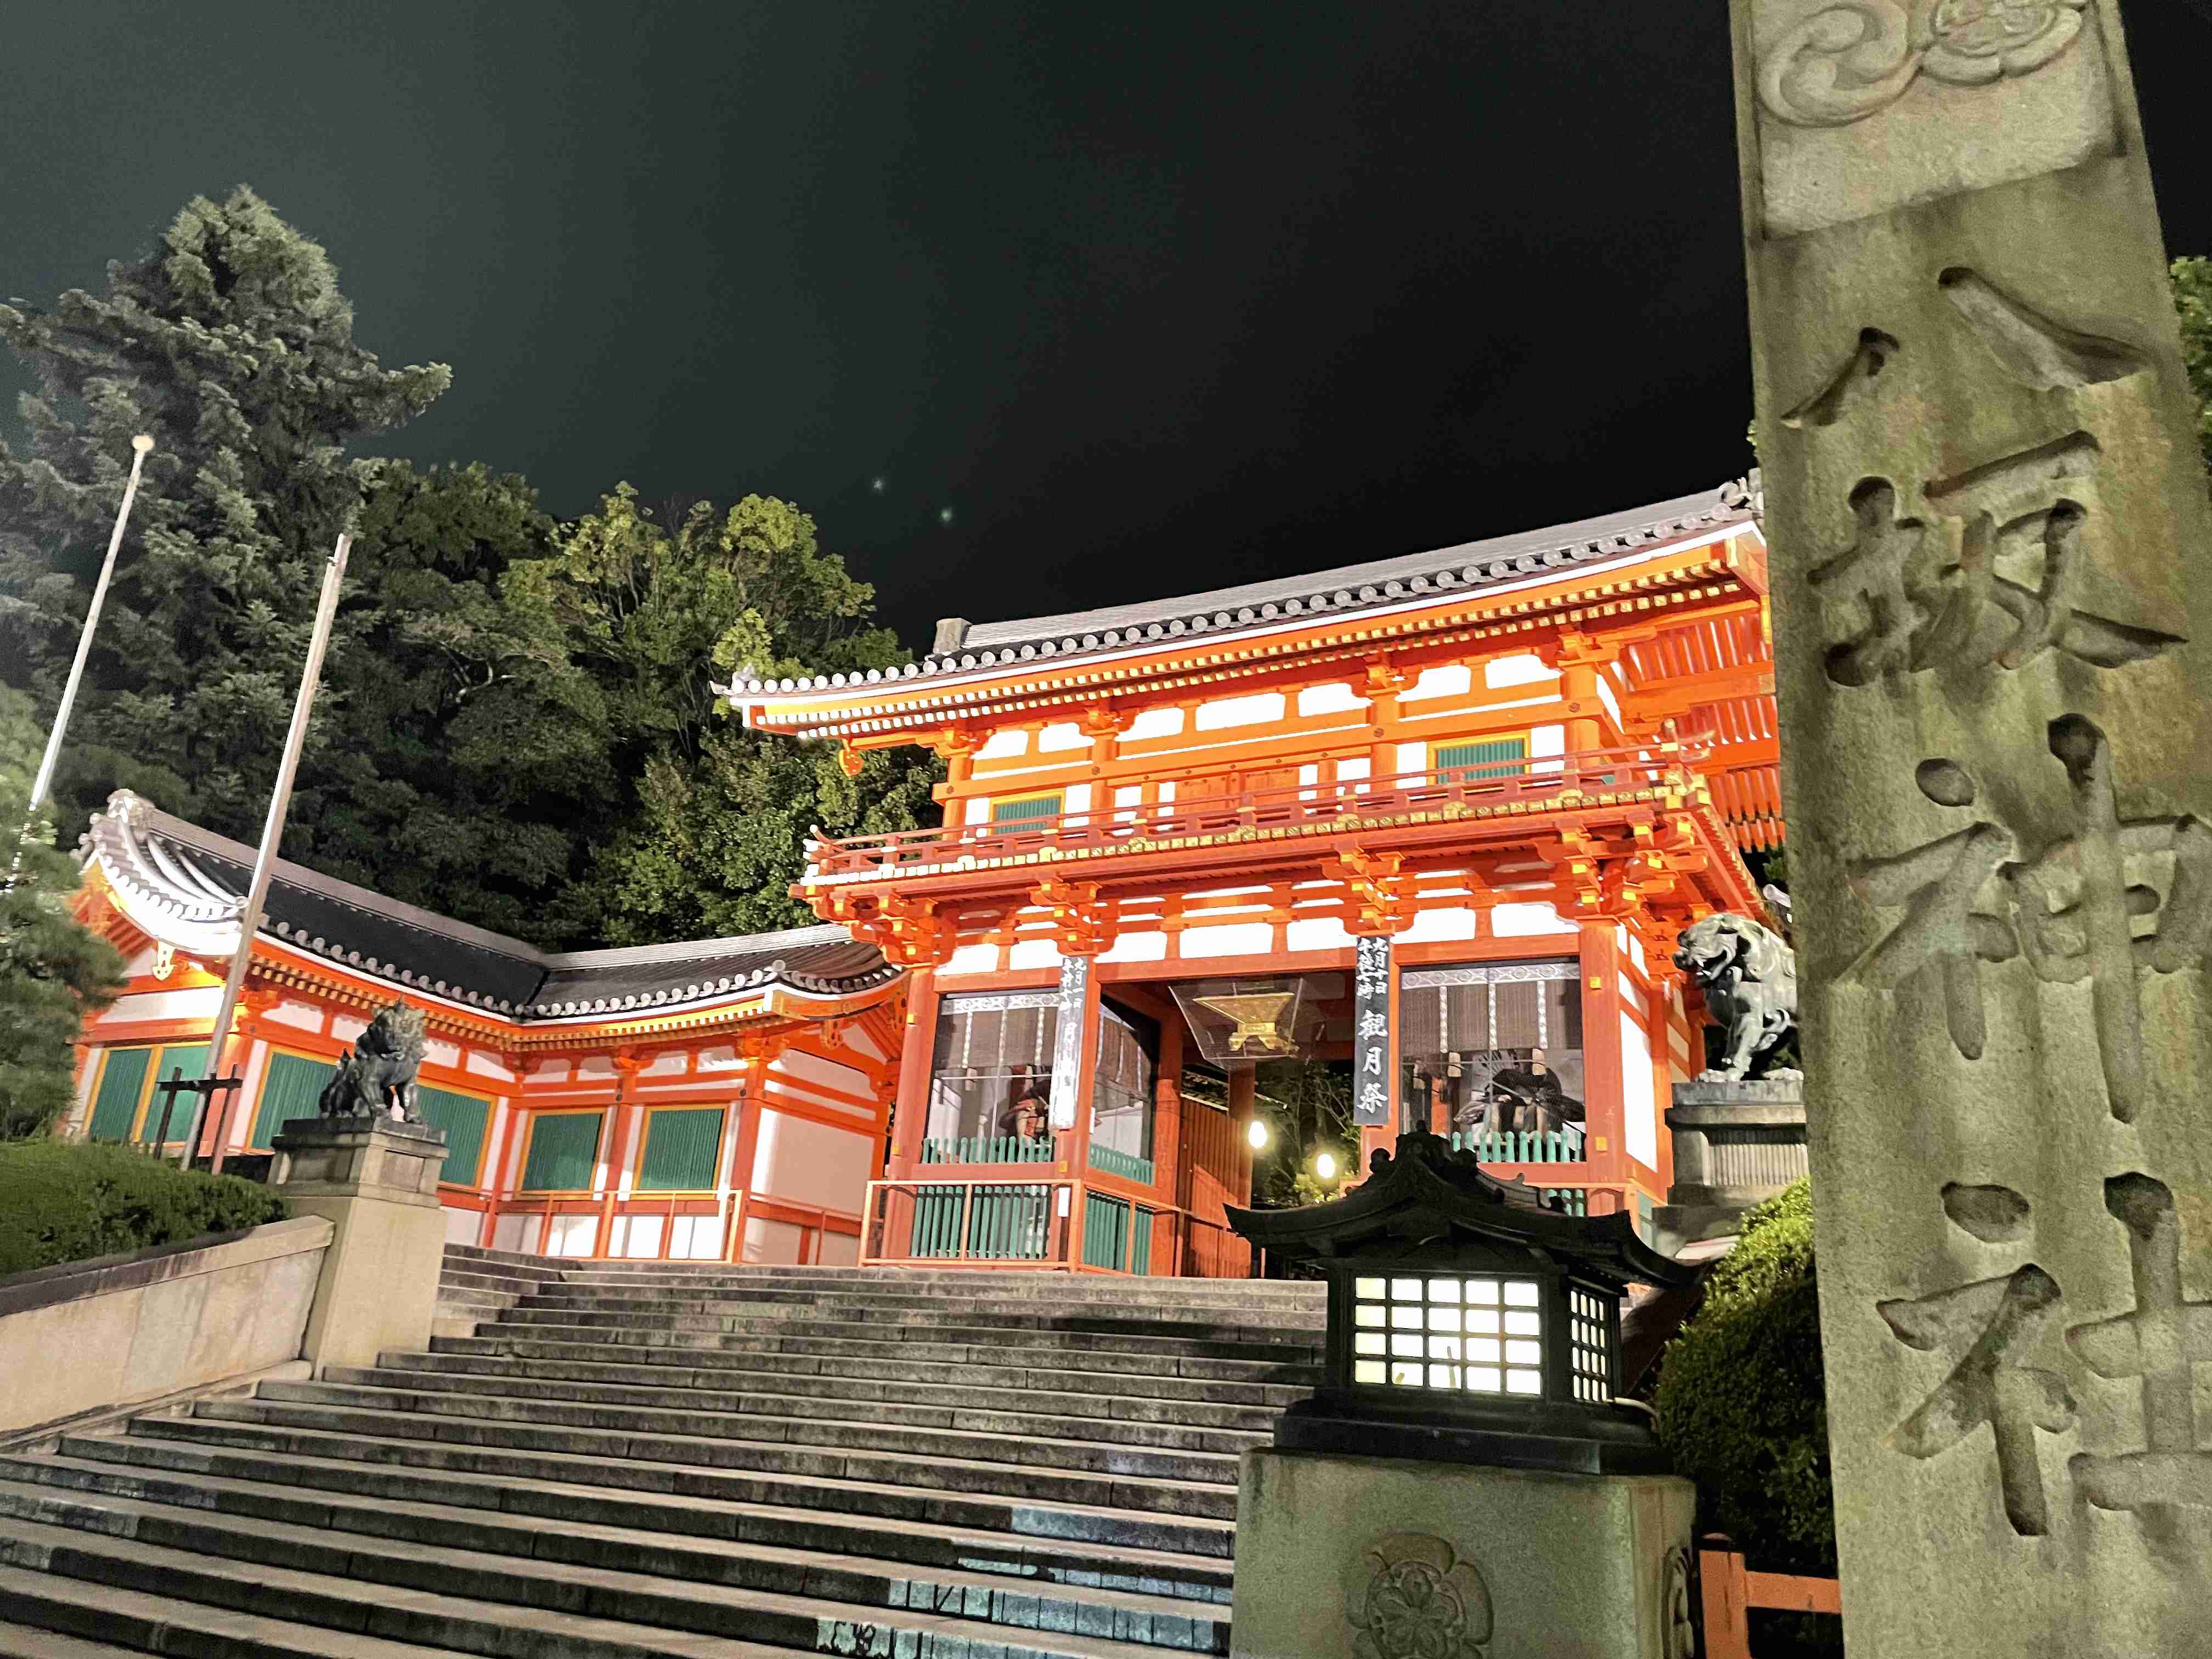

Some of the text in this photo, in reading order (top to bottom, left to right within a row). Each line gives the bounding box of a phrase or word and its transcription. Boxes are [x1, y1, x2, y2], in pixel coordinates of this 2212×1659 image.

[1372, 937, 1389, 994] 九月十日
[1357, 1009, 1389, 1114] 観月祭
